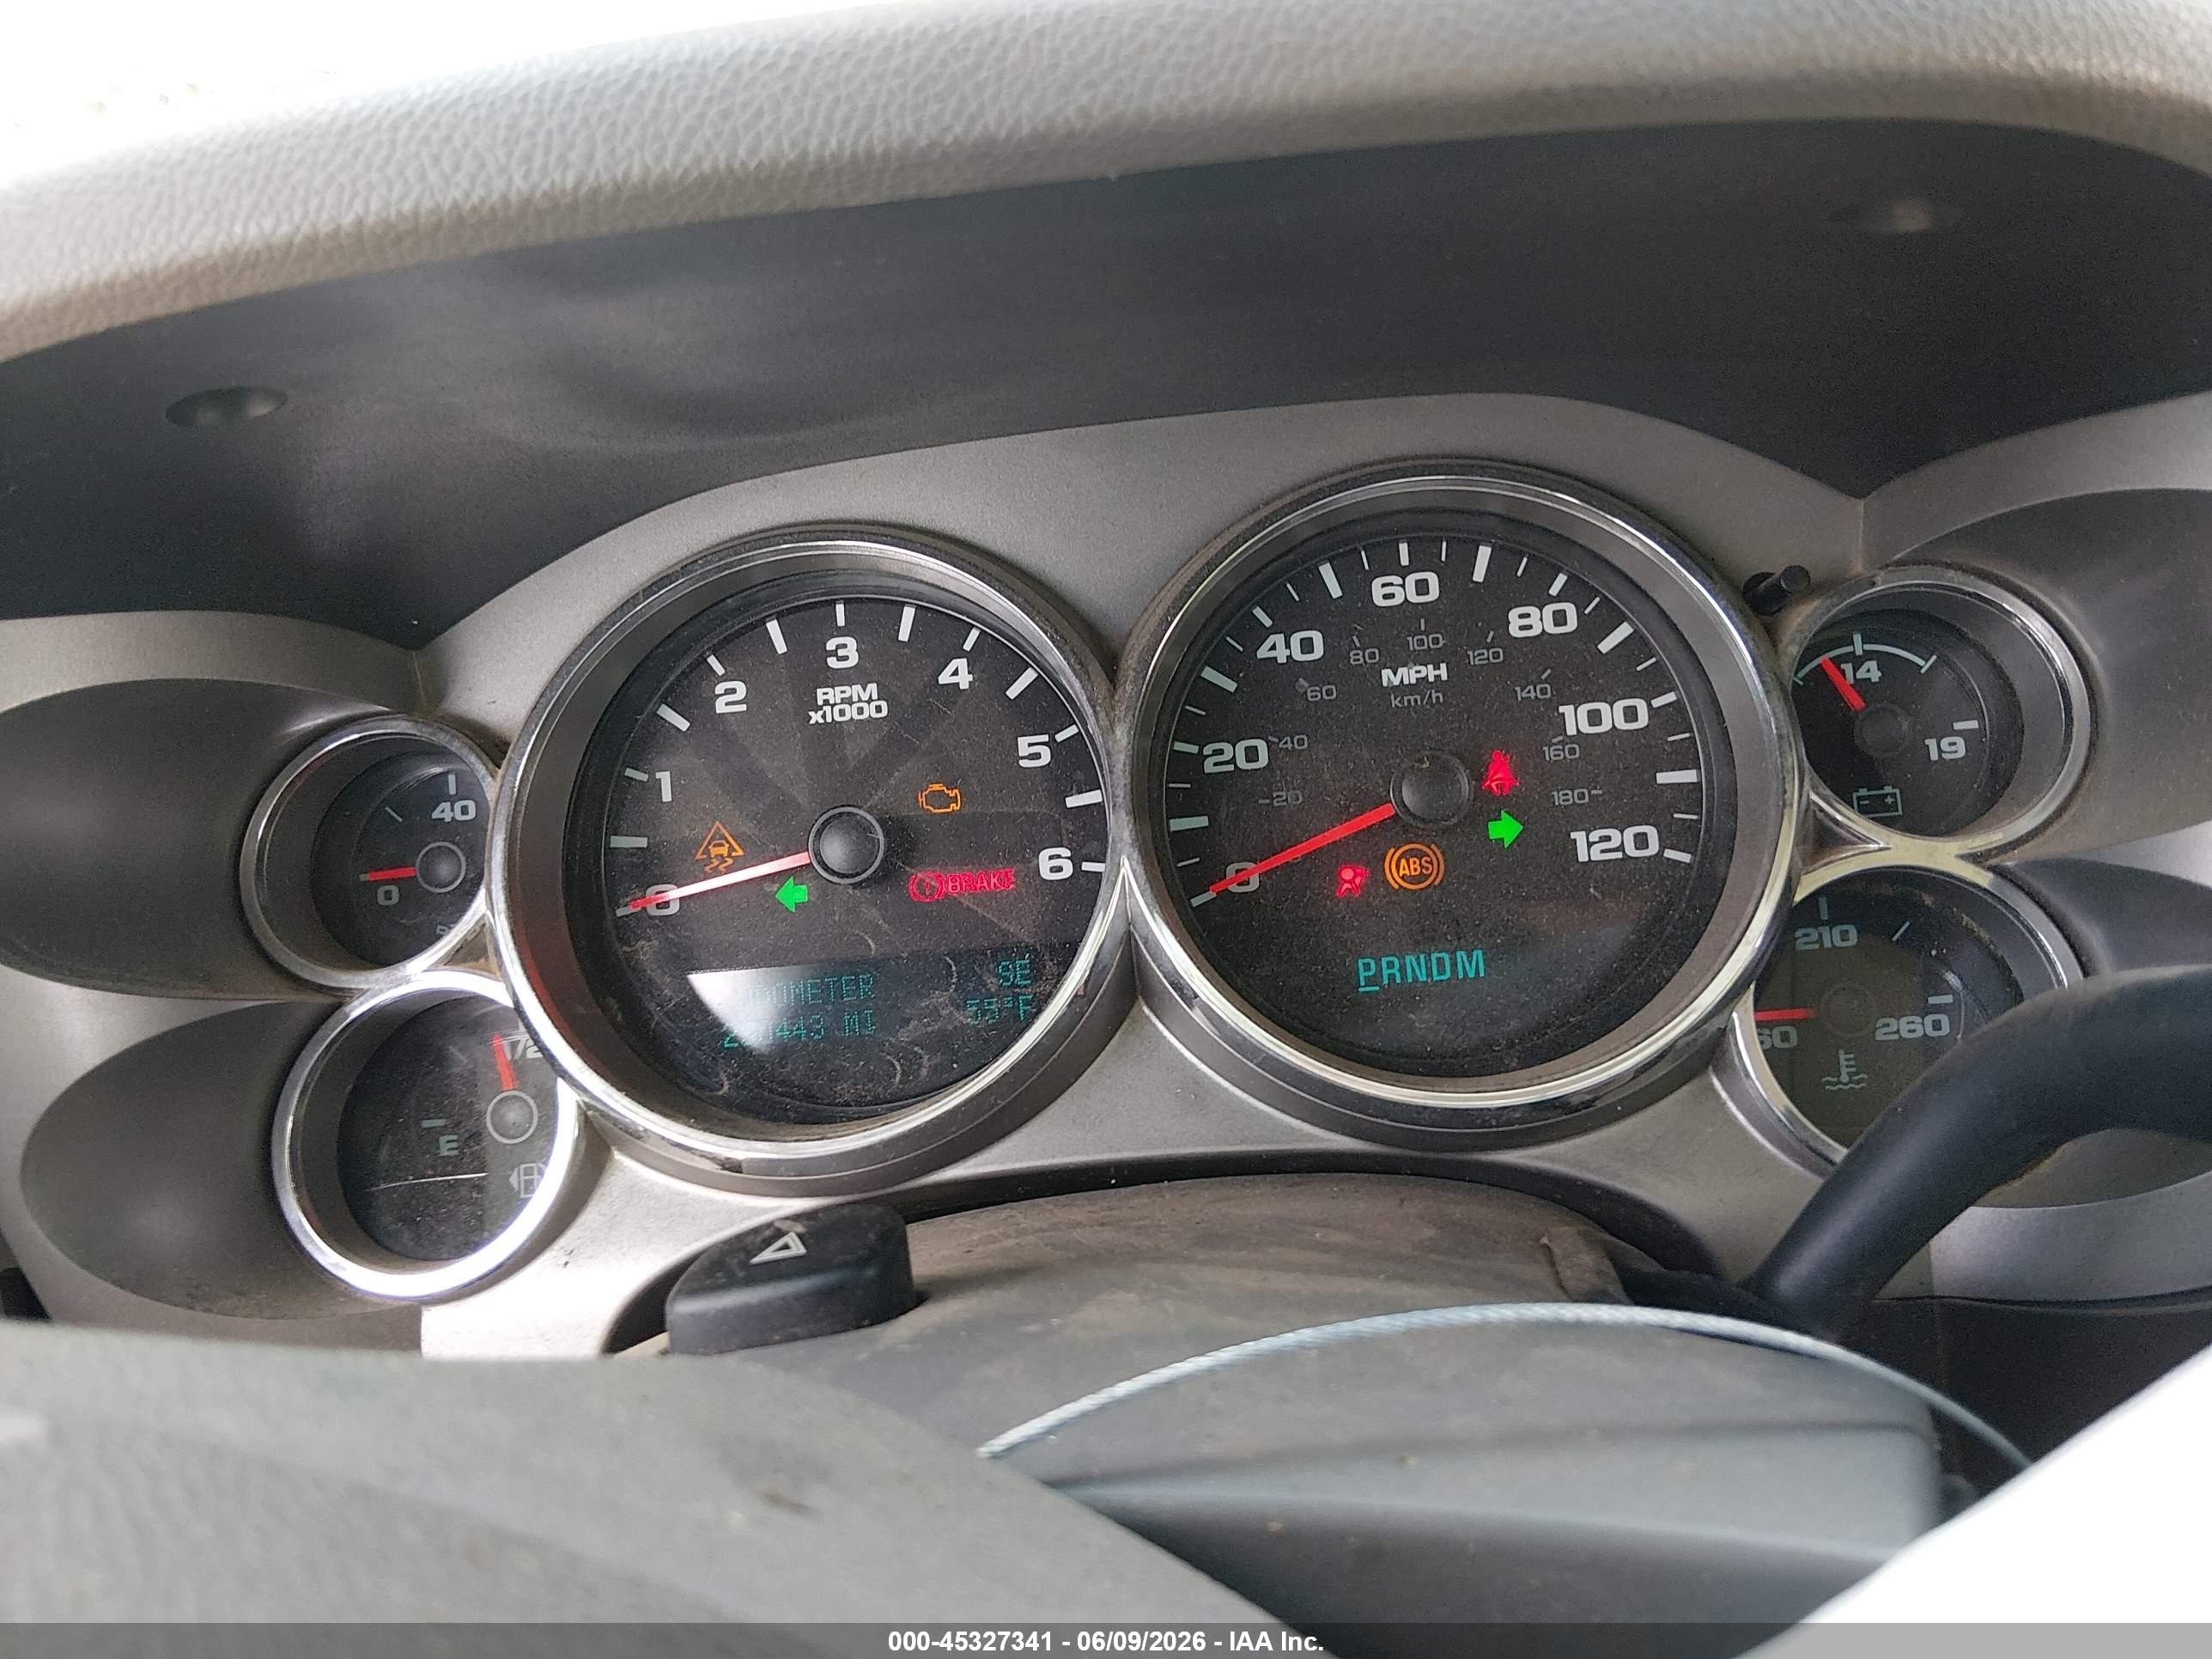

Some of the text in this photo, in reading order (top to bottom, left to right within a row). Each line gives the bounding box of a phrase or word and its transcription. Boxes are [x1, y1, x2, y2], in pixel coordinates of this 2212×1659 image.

[1371, 571, 1440, 607] 60
[1508, 602, 1577, 638] 80
[825, 636, 859, 669] 3
[1256, 630, 1324, 664] 40
[1407, 634, 1443, 650] 100
[1349, 648, 1380, 665] 80
[1468, 647, 1503, 665] 120
[938, 658, 974, 690] 4
[1381, 663, 1448, 687] MPH
[1840, 660, 1882, 684] 14
[715, 681, 746, 714] 2
[817, 684, 878, 706] RPM
[1306, 685, 1337, 702] 60
[1390, 690, 1444, 708] km/h
[1514, 684, 1552, 702] 140
[808, 701, 888, 725] x1000
[1559, 698, 1649, 736] 100
[1018, 734, 1051, 767] 5
[1279, 734, 1308, 750] 40
[1542, 744, 1580, 762] 160
[1924, 737, 1966, 761] 19
[1203, 738, 1269, 773] 20
[656, 771, 672, 802] 1
[1273, 790, 1303, 807] 20
[1553, 788, 1589, 805] 180
[432, 799, 476, 822] 40
[1570, 825, 1659, 862] 120
[1038, 848, 1073, 880] 6
[1399, 856, 1433, 878] ABS
[947, 868, 1015, 895] BRAKE
[1225, 861, 1260, 893] 0
[377, 885, 399, 904] 0
[646, 884, 680, 916] 0
[1795, 924, 1858, 950] 210
[999, 958, 1030, 986] SE
[844, 1008, 875, 1036] MI
[1875, 1013, 1950, 1041] 260
[439, 1134, 459, 1156] E
